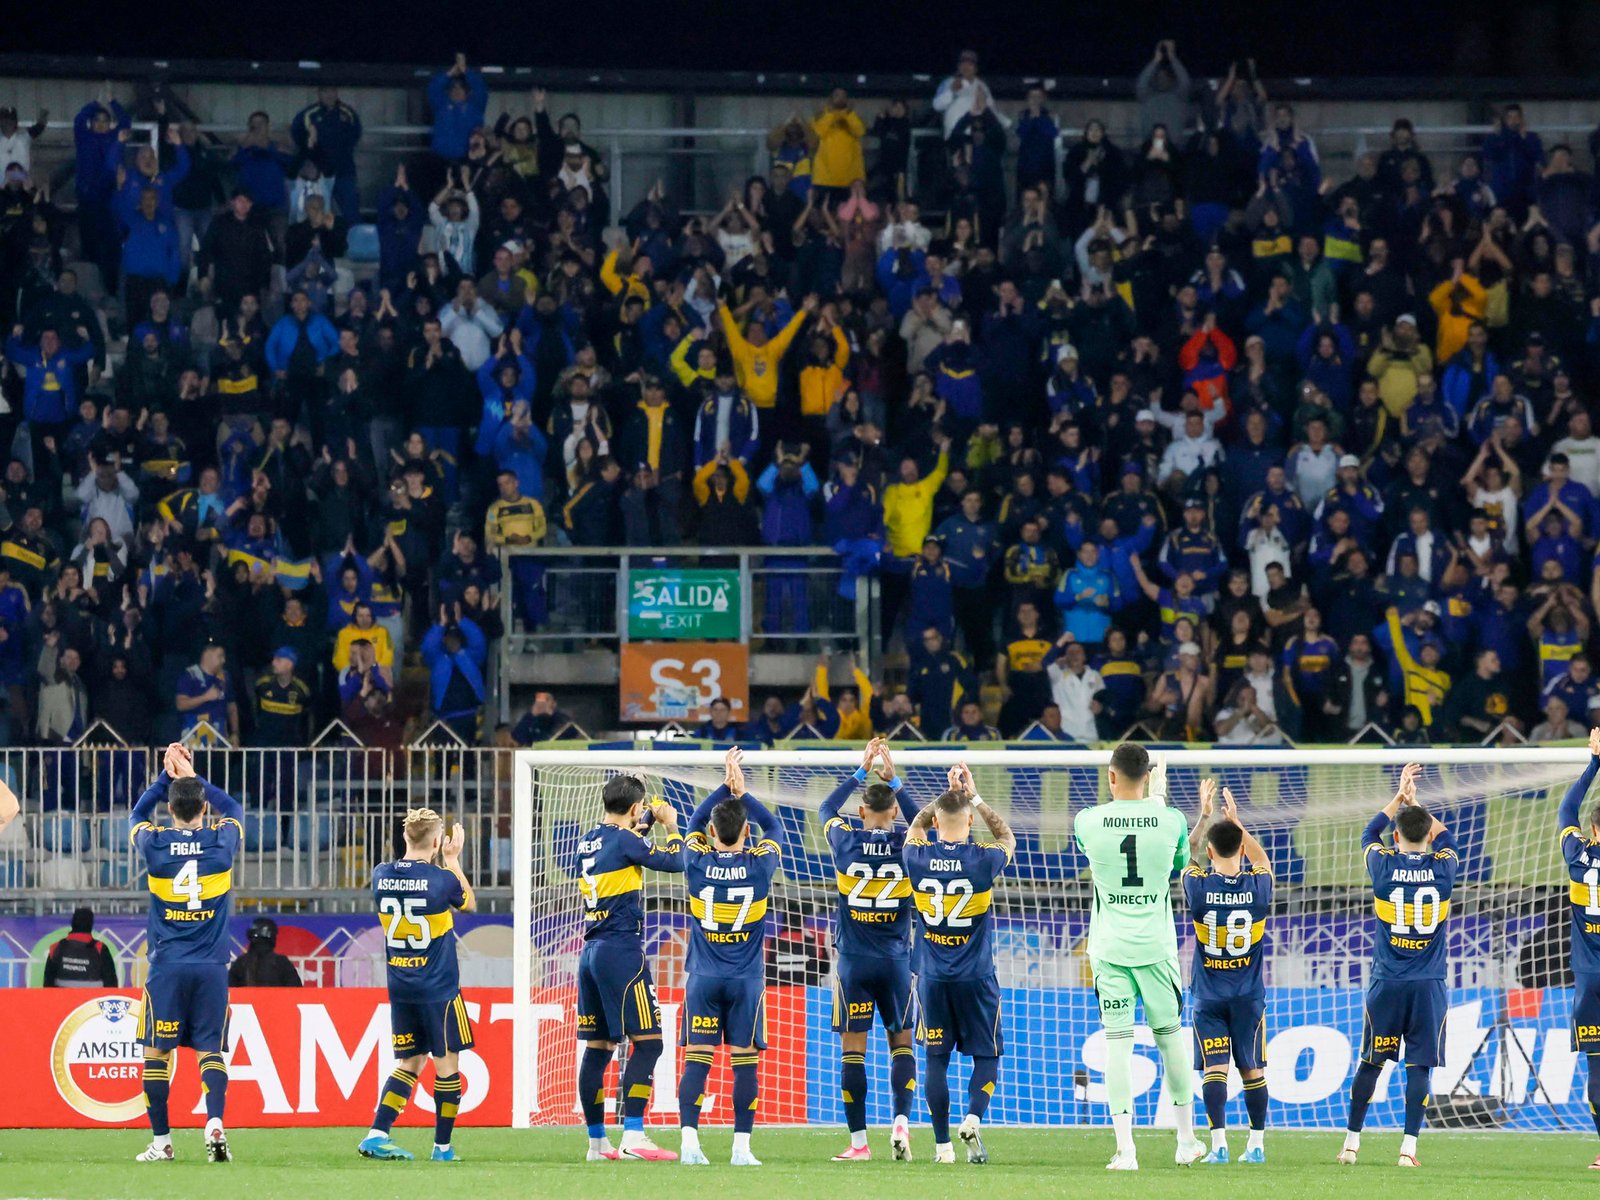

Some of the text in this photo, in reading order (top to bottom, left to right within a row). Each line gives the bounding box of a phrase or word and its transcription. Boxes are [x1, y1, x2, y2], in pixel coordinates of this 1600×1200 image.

[641, 585, 728, 608] SALIDA
[665, 614, 703, 627] EXIT
[650, 658, 722, 706] S3
[1103, 817, 1158, 828] MONTERO
[170, 842, 203, 855] FIGAL
[862, 842, 891, 856] VILLA
[929, 859, 962, 872] COSTA
[1120, 834, 1144, 887] 1
[705, 865, 747, 880] LOZANO
[1391, 868, 1435, 882] ARANDA
[173, 859, 203, 910] 4
[378, 878, 428, 891] ASCACIBAR
[581, 857, 598, 909] 5
[846, 862, 903, 908] 22
[918, 878, 973, 927] 32
[1108, 893, 1158, 905] DIRECTV
[1206, 891, 1253, 905] DELGADO
[165, 908, 215, 921] DIRECTV
[699, 886, 754, 932] 17
[850, 909, 897, 923] DIRECTV
[1388, 886, 1440, 934] 10
[380, 897, 431, 949] 25
[705, 931, 750, 943] IRECTV
[1203, 910, 1253, 956] 18
[1390, 935, 1432, 950] DIRECT
[1203, 956, 1251, 969] DIRECTV
[849, 1001, 873, 1015] pax
[1103, 998, 1129, 1011] pax
[156, 1020, 180, 1032] pax
[692, 1015, 719, 1028] pax
[927, 1028, 943, 1040] ax
[1203, 1036, 1229, 1051] pax
[1374, 1035, 1399, 1048] pax
[77, 1041, 141, 1058] AMSTE
[88, 1066, 139, 1079] LAGER
